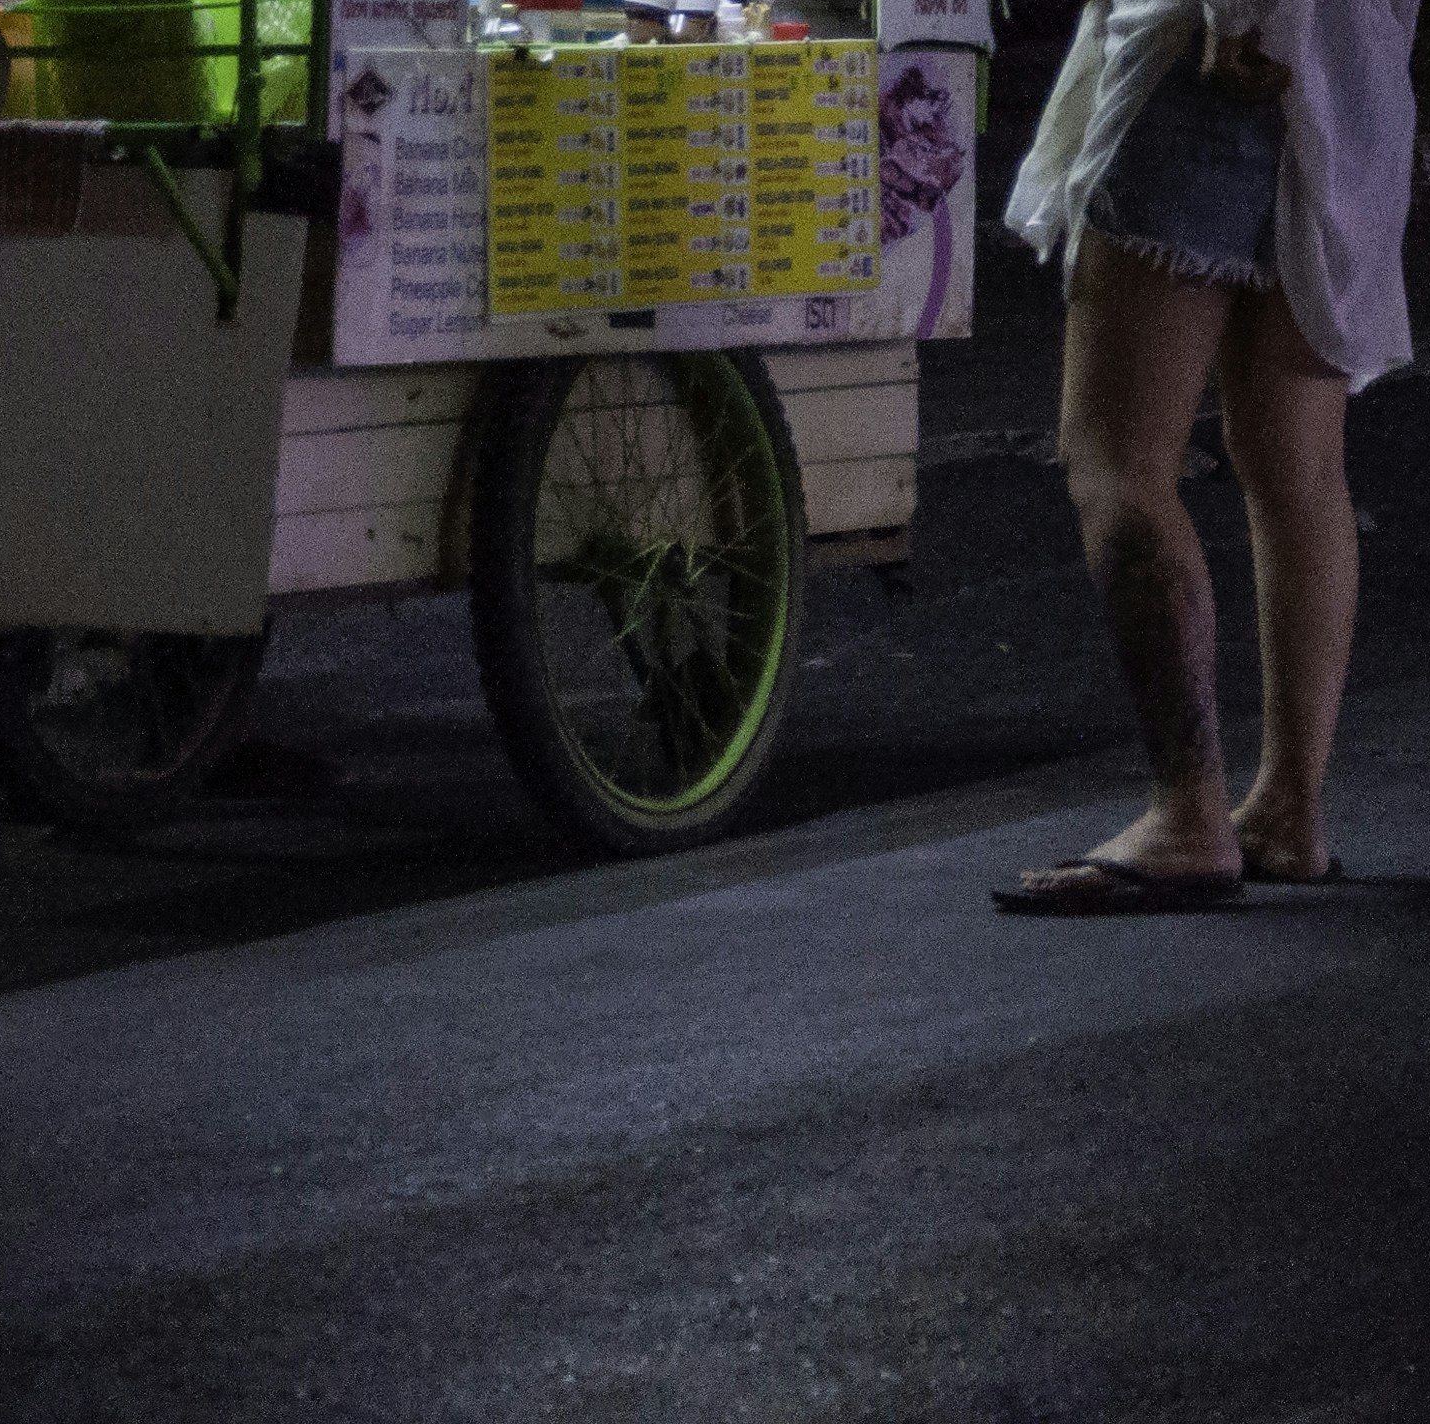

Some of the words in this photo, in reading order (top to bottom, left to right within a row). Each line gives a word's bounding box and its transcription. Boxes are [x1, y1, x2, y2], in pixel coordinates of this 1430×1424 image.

[395, 136, 448, 160] Banana
[395, 171, 448, 196] Banana
[393, 208, 448, 230] Banana
[392, 242, 446, 265] Banana
[391, 276, 462, 302] Pineapple
[389, 311, 433, 340] Sugar
